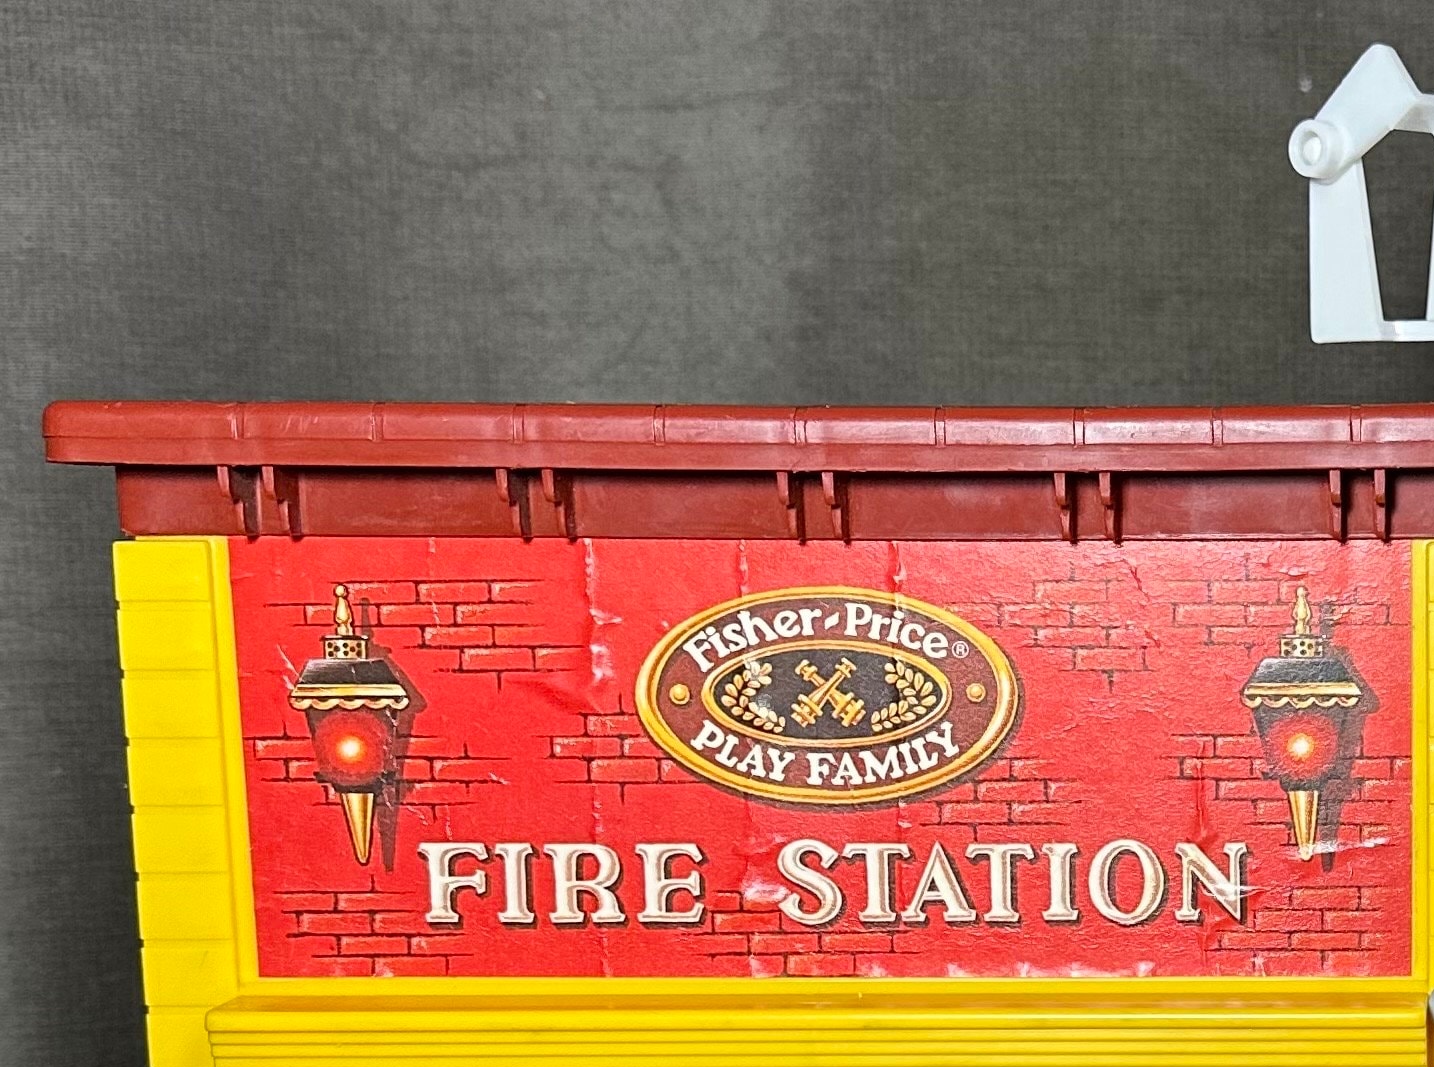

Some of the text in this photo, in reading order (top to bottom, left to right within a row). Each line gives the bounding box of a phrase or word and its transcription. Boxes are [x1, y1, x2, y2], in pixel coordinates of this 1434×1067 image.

[690, 720, 961, 786] PLAY FAMILY
[417, 840, 1252, 928] FIRE STATION
